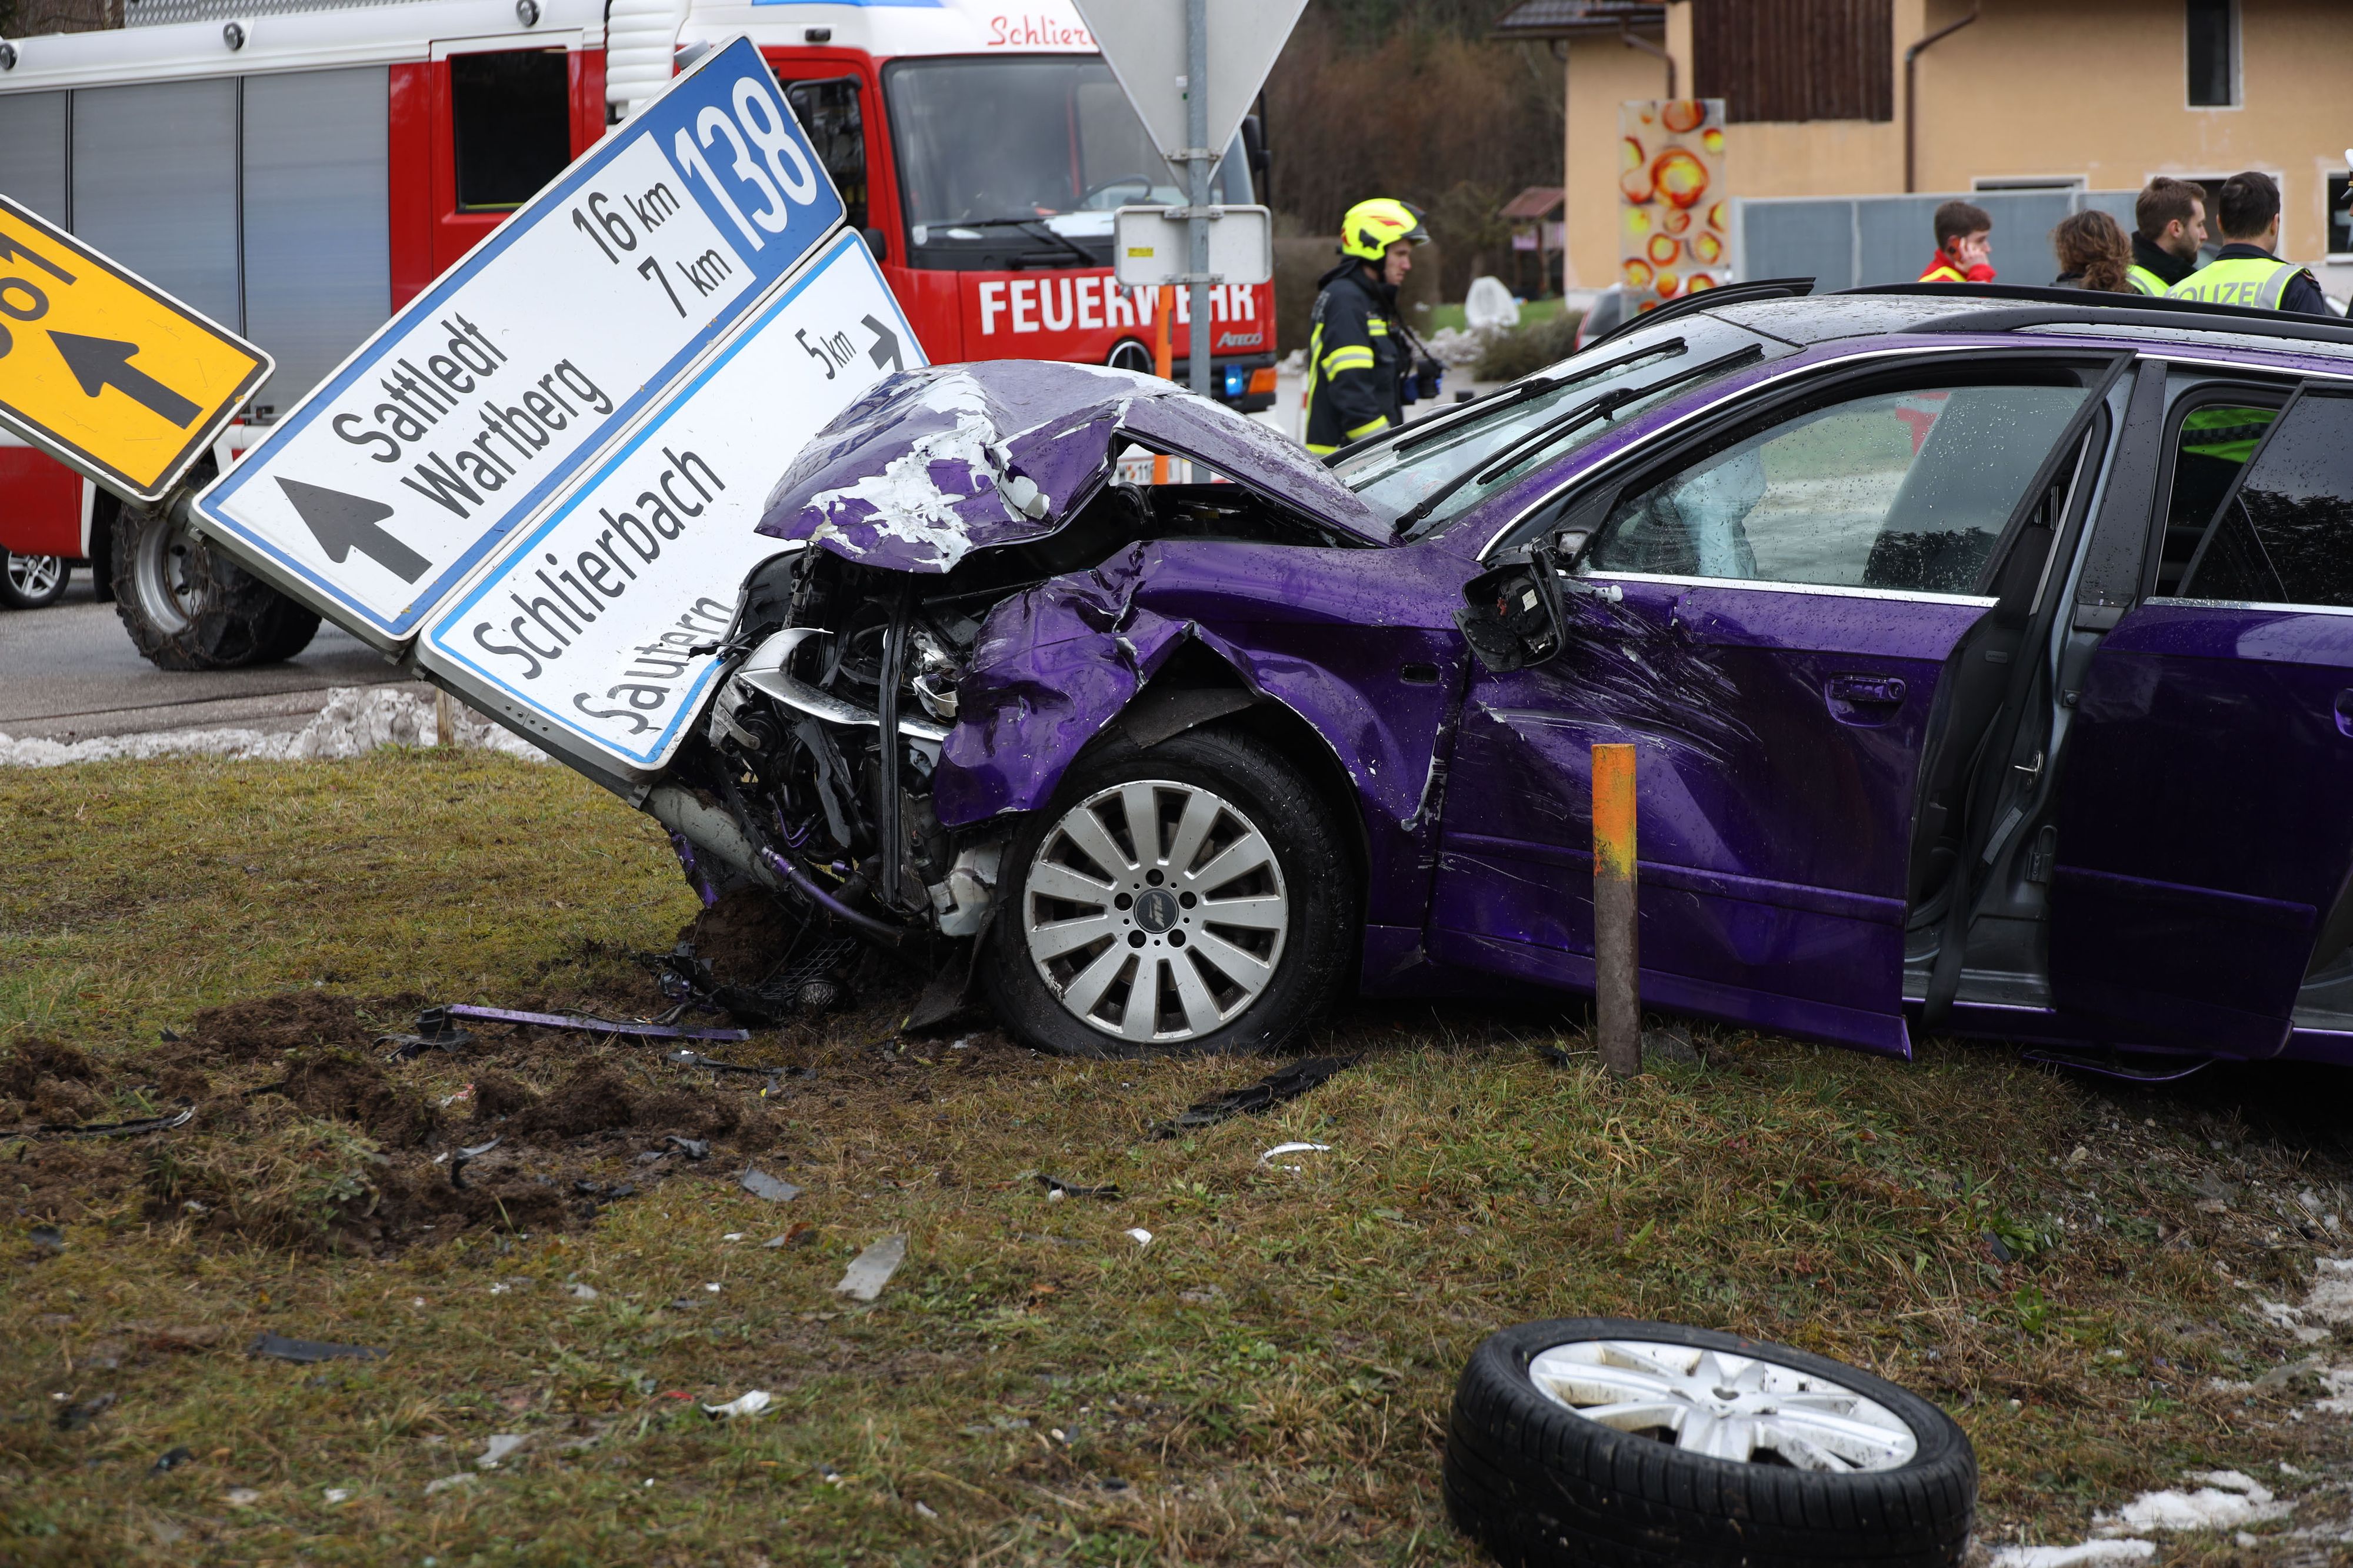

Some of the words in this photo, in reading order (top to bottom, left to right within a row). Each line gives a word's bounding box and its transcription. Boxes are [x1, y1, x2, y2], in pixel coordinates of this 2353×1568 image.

[988, 15, 1097, 46] Schlier
[675, 76, 817, 252] 138
[332, 312, 508, 463] Sattledt
[572, 192, 637, 265] 16
[624, 182, 681, 233] km
[2169, 282, 2264, 306] OLIZEI
[400, 358, 614, 519] Wartberg
[637, 255, 687, 319] 7
[675, 249, 732, 298] km
[472, 446, 726, 680] Schlierbach
[795, 328, 835, 380] 5
[825, 330, 856, 369] km
[573, 597, 735, 735] Sautern
